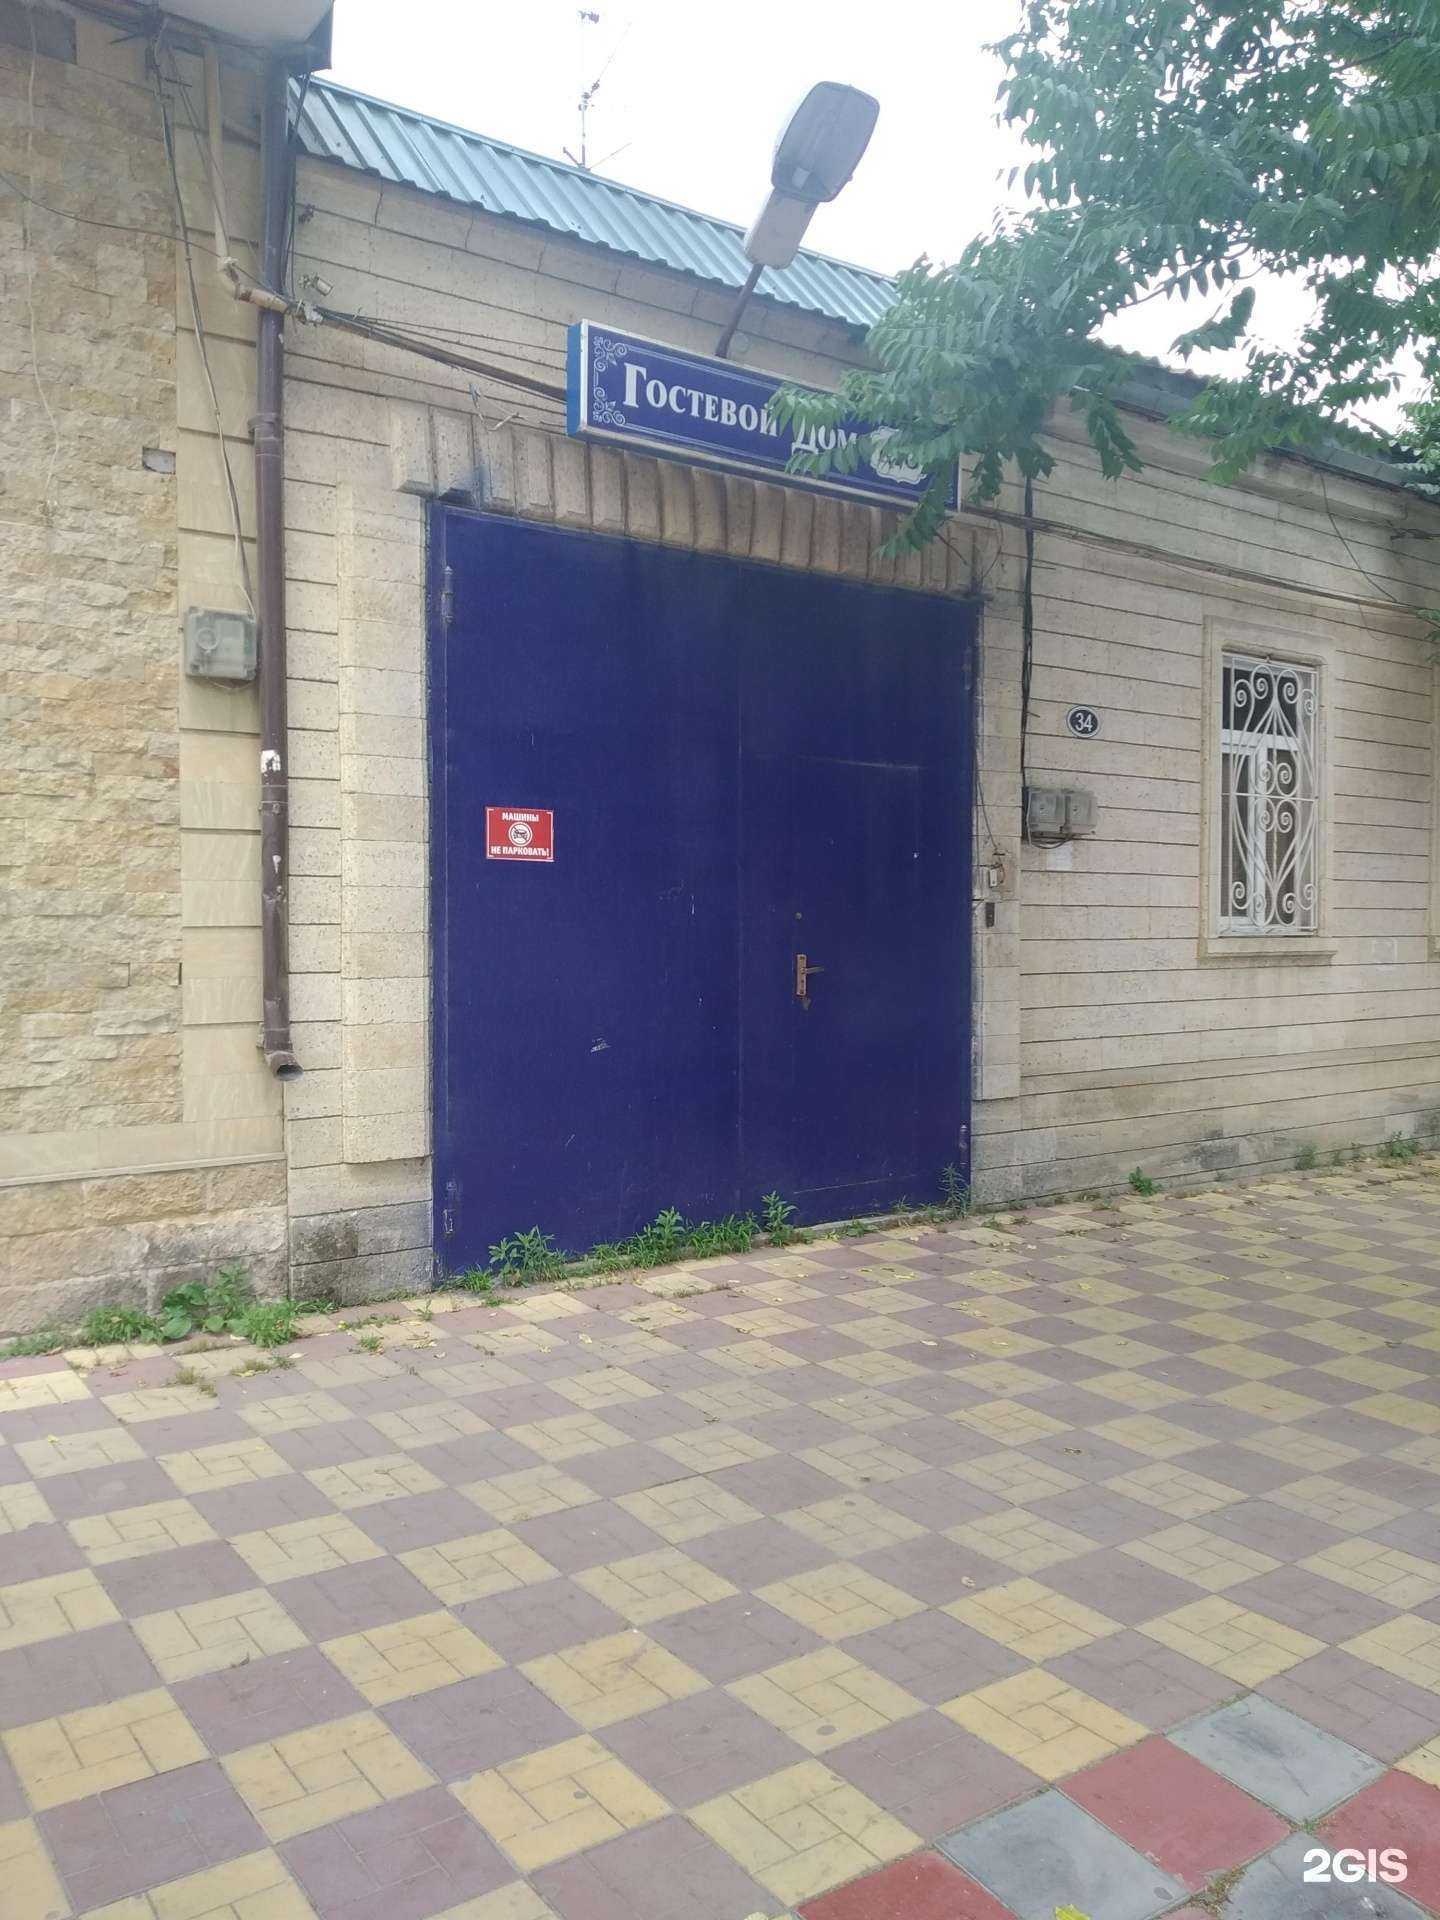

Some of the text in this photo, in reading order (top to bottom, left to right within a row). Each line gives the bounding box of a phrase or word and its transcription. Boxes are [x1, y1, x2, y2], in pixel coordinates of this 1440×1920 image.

[1075, 712, 1093, 732] 34
[502, 812, 540, 822] МАШИНЫ
[490, 845, 550, 856] НЕ ПАРКОВАТЬ!
